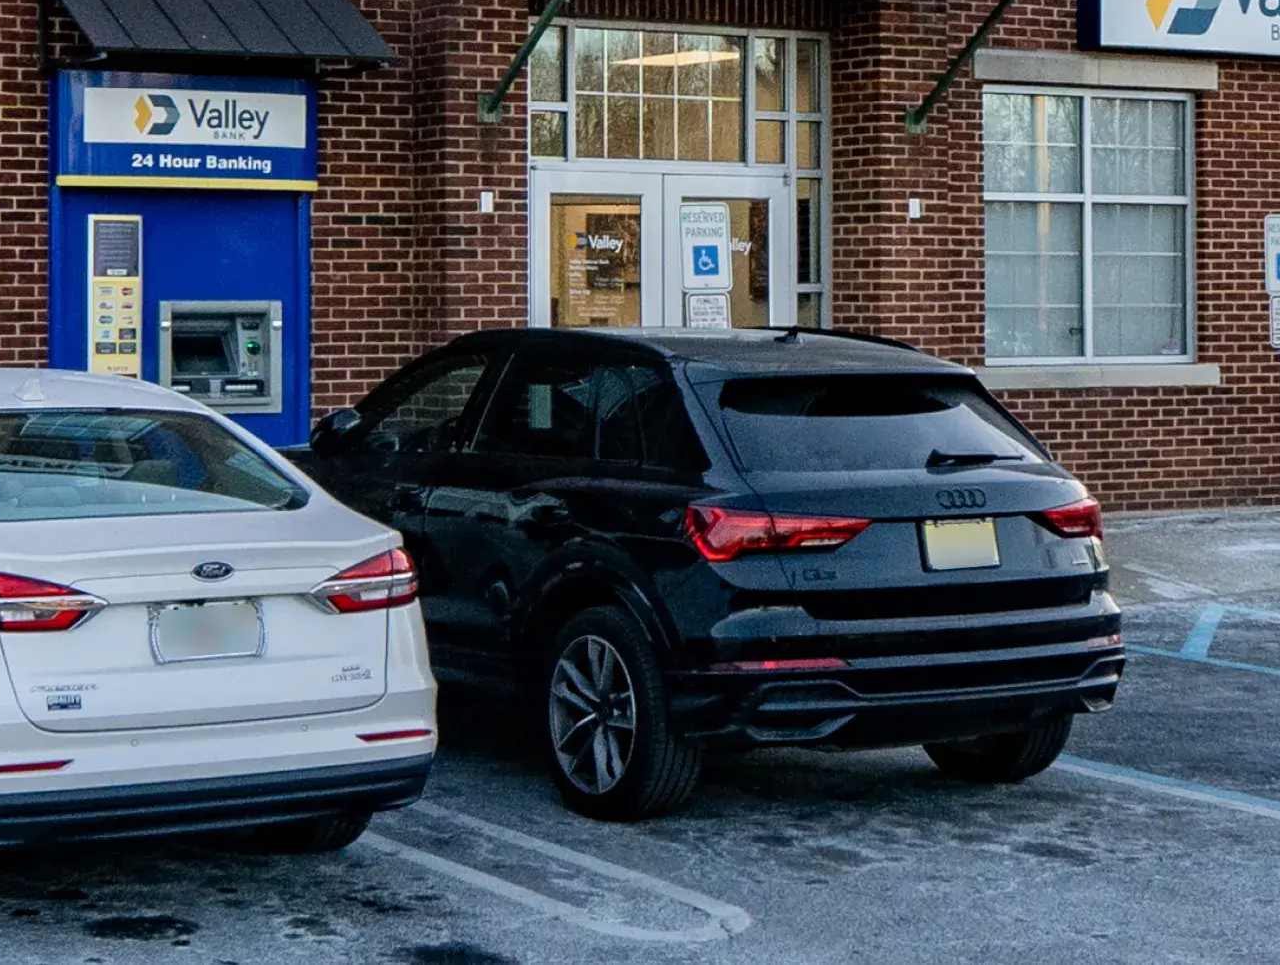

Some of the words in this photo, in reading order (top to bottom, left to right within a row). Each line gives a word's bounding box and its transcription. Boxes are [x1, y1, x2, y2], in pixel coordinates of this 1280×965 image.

[188, 98, 270, 140] Valley
[213, 131, 245, 140] BANK
[131, 153, 153, 168] 24
[159, 154, 202, 169] Hour
[206, 155, 273, 173] Banking
[682, 211, 725, 224] RESERVED
[685, 226, 724, 238] PARKING
[588, 234, 624, 254] Valley
[729, 237, 752, 256] lley
